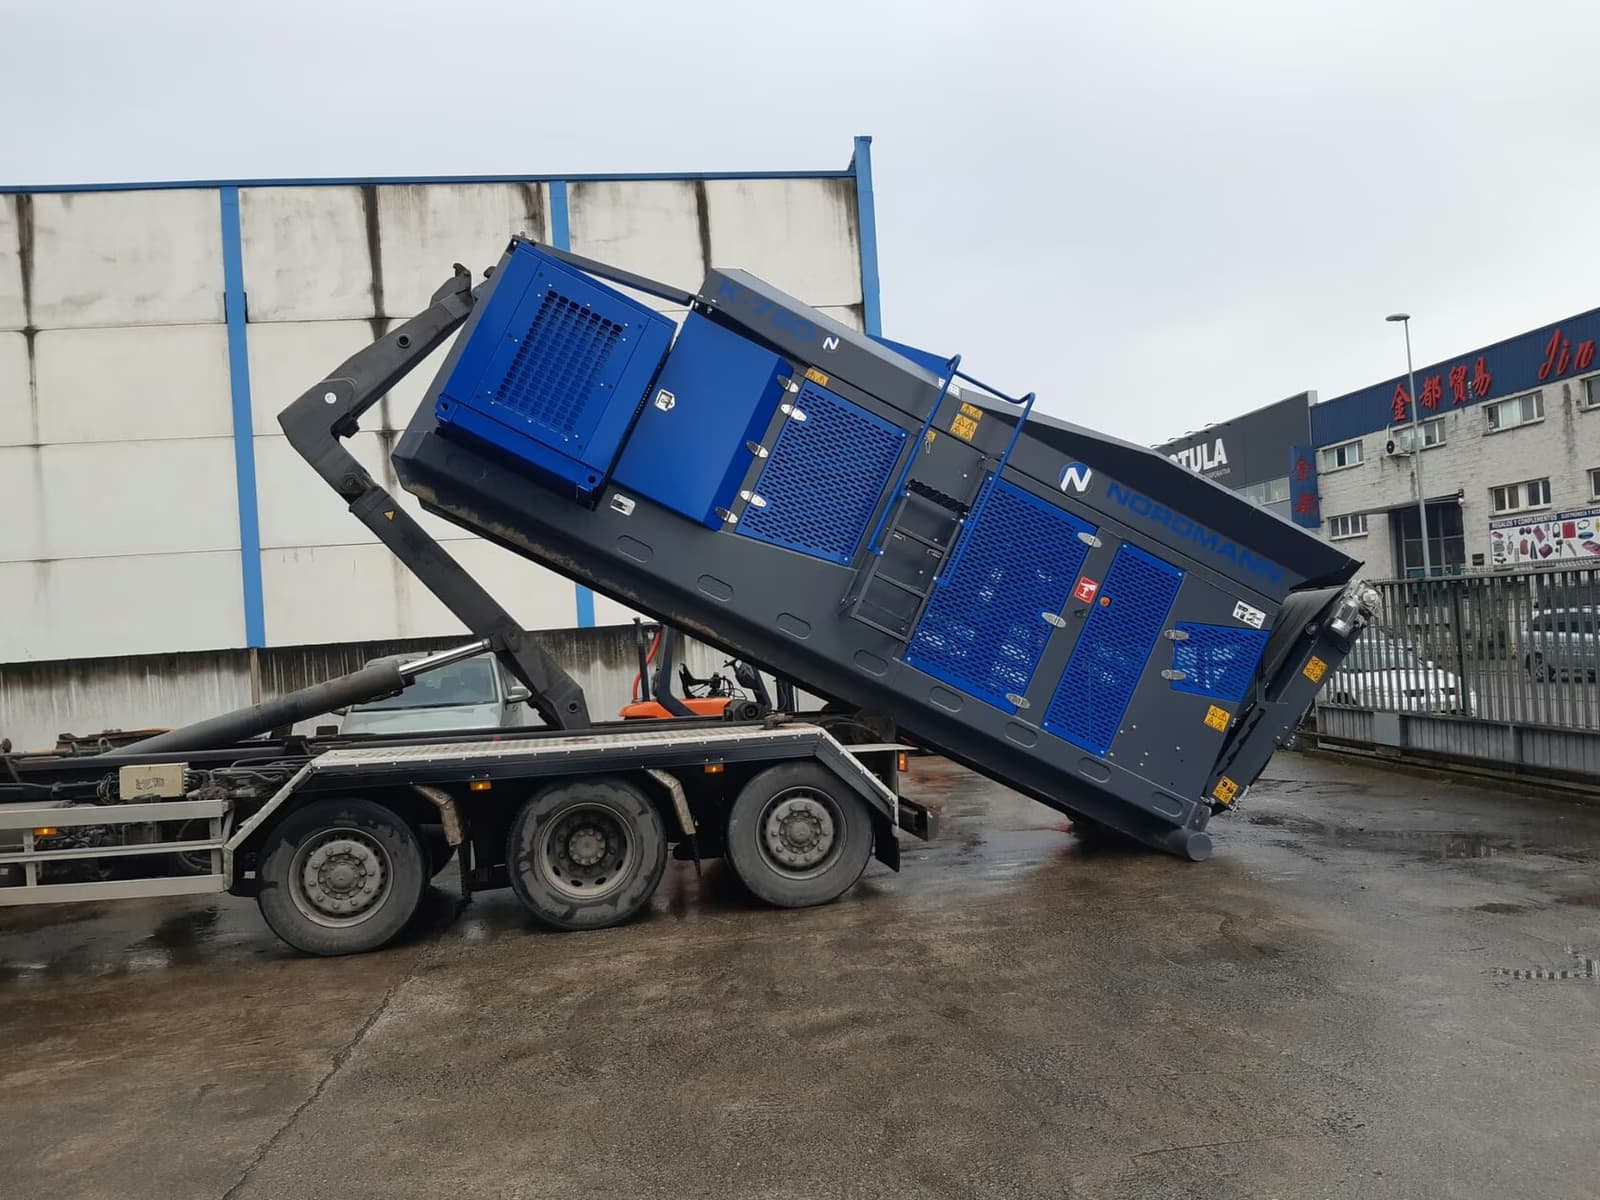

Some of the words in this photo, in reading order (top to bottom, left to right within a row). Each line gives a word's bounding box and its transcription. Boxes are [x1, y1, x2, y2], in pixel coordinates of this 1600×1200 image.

[1391, 356, 1493, 421] 金都贸易
[1106, 481, 1285, 586] NORDMANN
